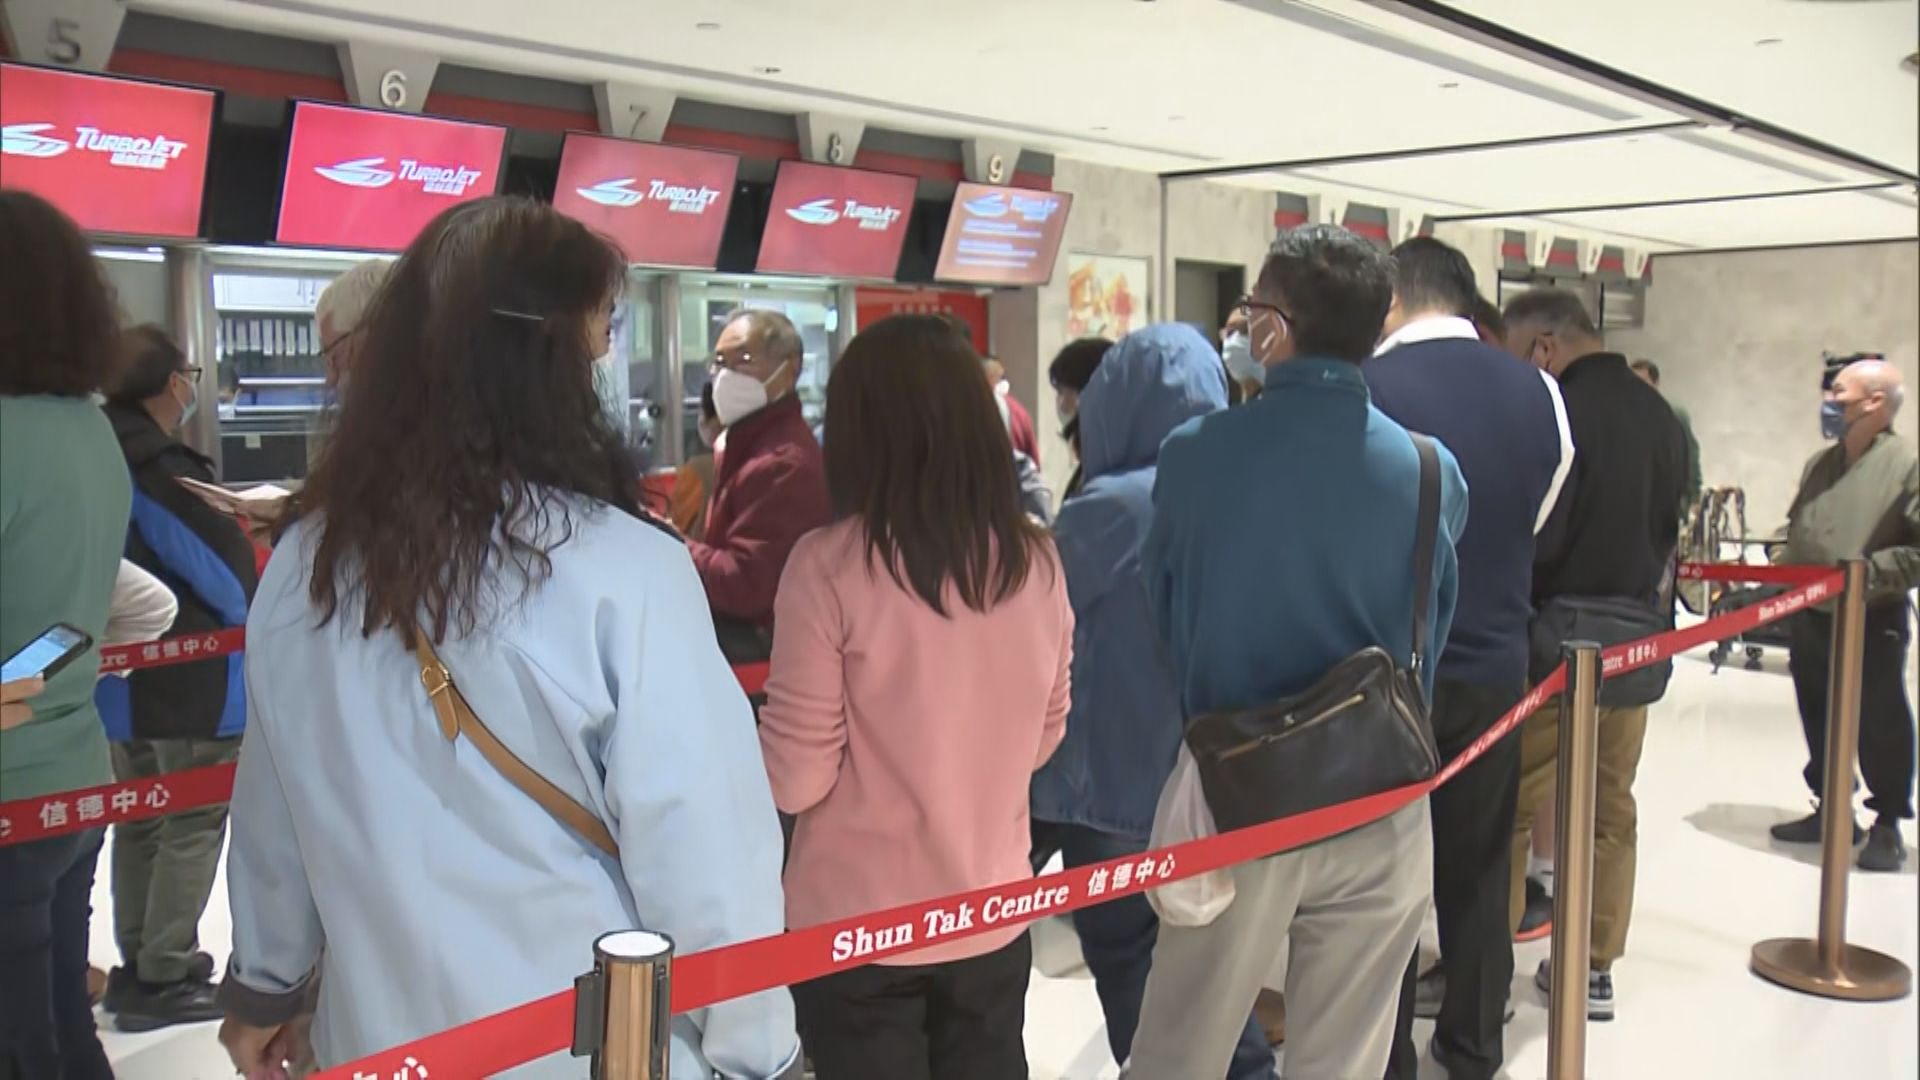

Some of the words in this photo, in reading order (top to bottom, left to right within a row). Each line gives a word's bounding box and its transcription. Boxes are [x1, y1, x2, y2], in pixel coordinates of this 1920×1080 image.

[47, 17, 81, 64] 5
[380, 69, 407, 108] 6
[629, 105, 649, 137] 7
[988, 154, 1004, 183] 9
[832, 922, 914, 962] Shun
[924, 902, 975, 938] Tak
[982, 885, 1070, 924] Centre
[1087, 853, 1176, 897] 信德中心
